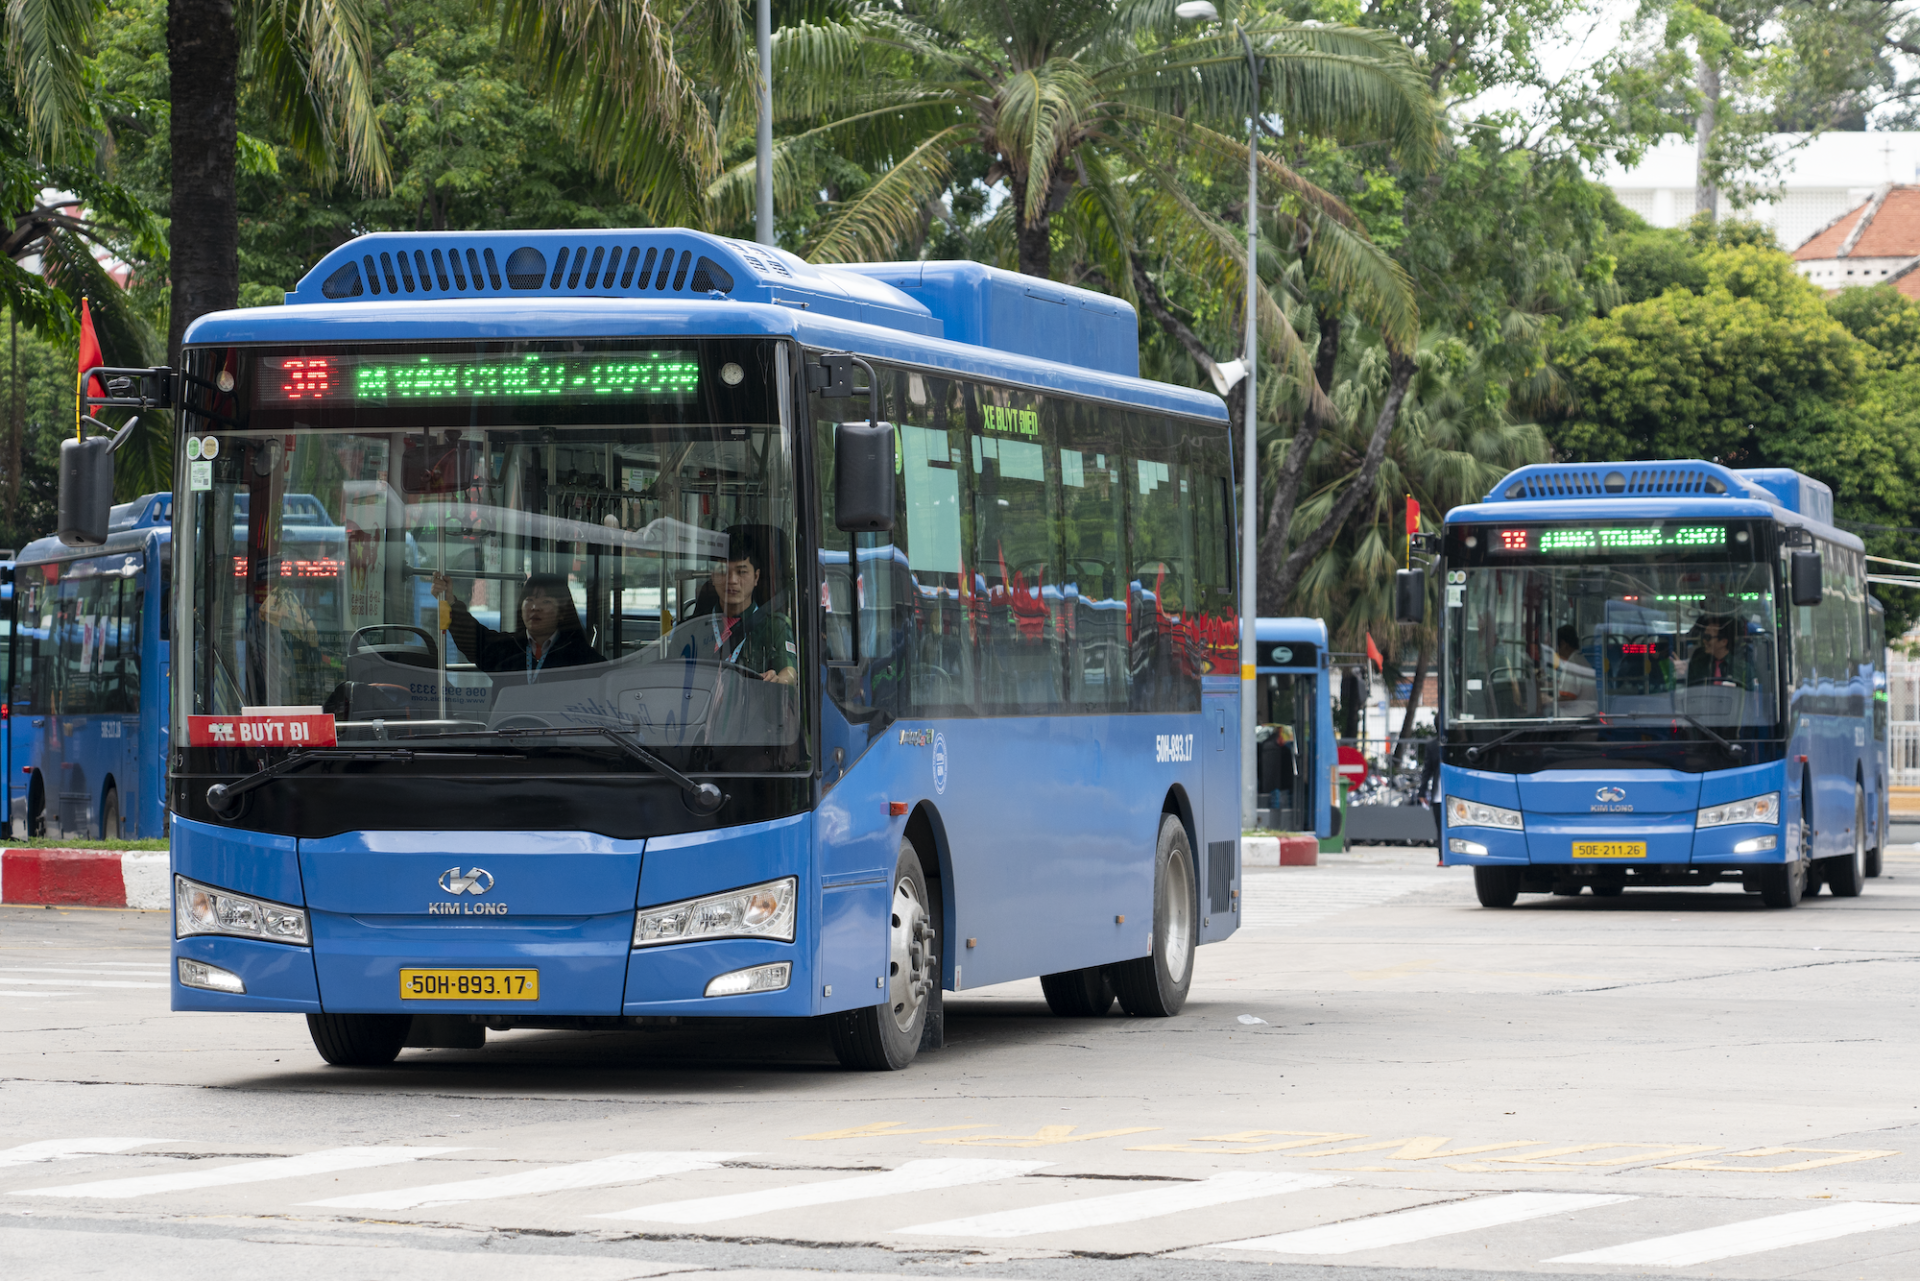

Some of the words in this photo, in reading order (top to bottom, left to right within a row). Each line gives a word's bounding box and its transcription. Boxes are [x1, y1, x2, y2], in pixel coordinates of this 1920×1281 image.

[982, 404, 996, 430] XE
[995, 400, 1018, 433] BUÝT
[239, 718, 285, 742] BUÝT
[289, 721, 310, 741] ĐI
[1156, 734, 1194, 763] 50H-893.17
[1590, 804, 1608, 812] KIM
[1610, 804, 1634, 812] LONG
[1578, 845, 1641, 855] 50E-211.26
[428, 902, 461, 915] KIM
[464, 902, 509, 915] LONG
[412, 975, 526, 994] 50H-893.17
